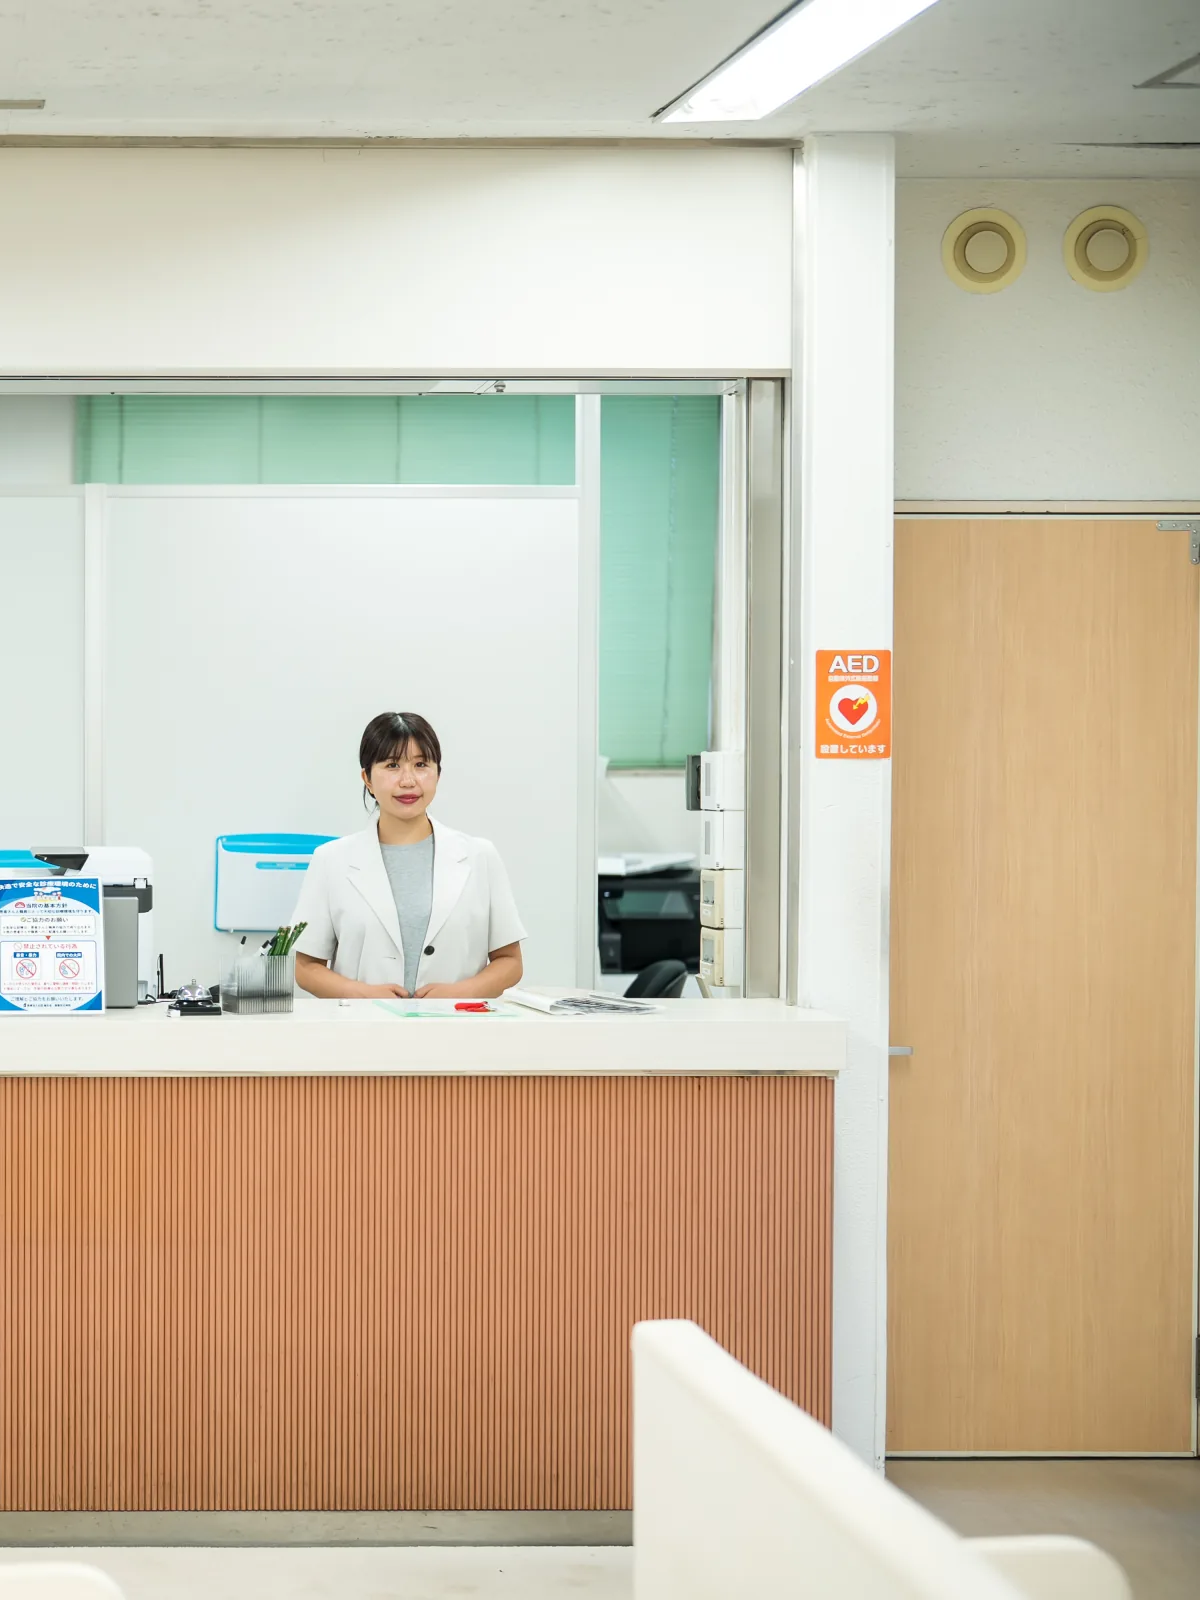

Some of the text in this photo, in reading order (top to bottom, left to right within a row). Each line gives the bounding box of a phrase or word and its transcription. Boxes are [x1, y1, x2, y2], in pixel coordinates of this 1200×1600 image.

[828, 655, 880, 673] AED
[820, 744, 886, 754] 設置しています
